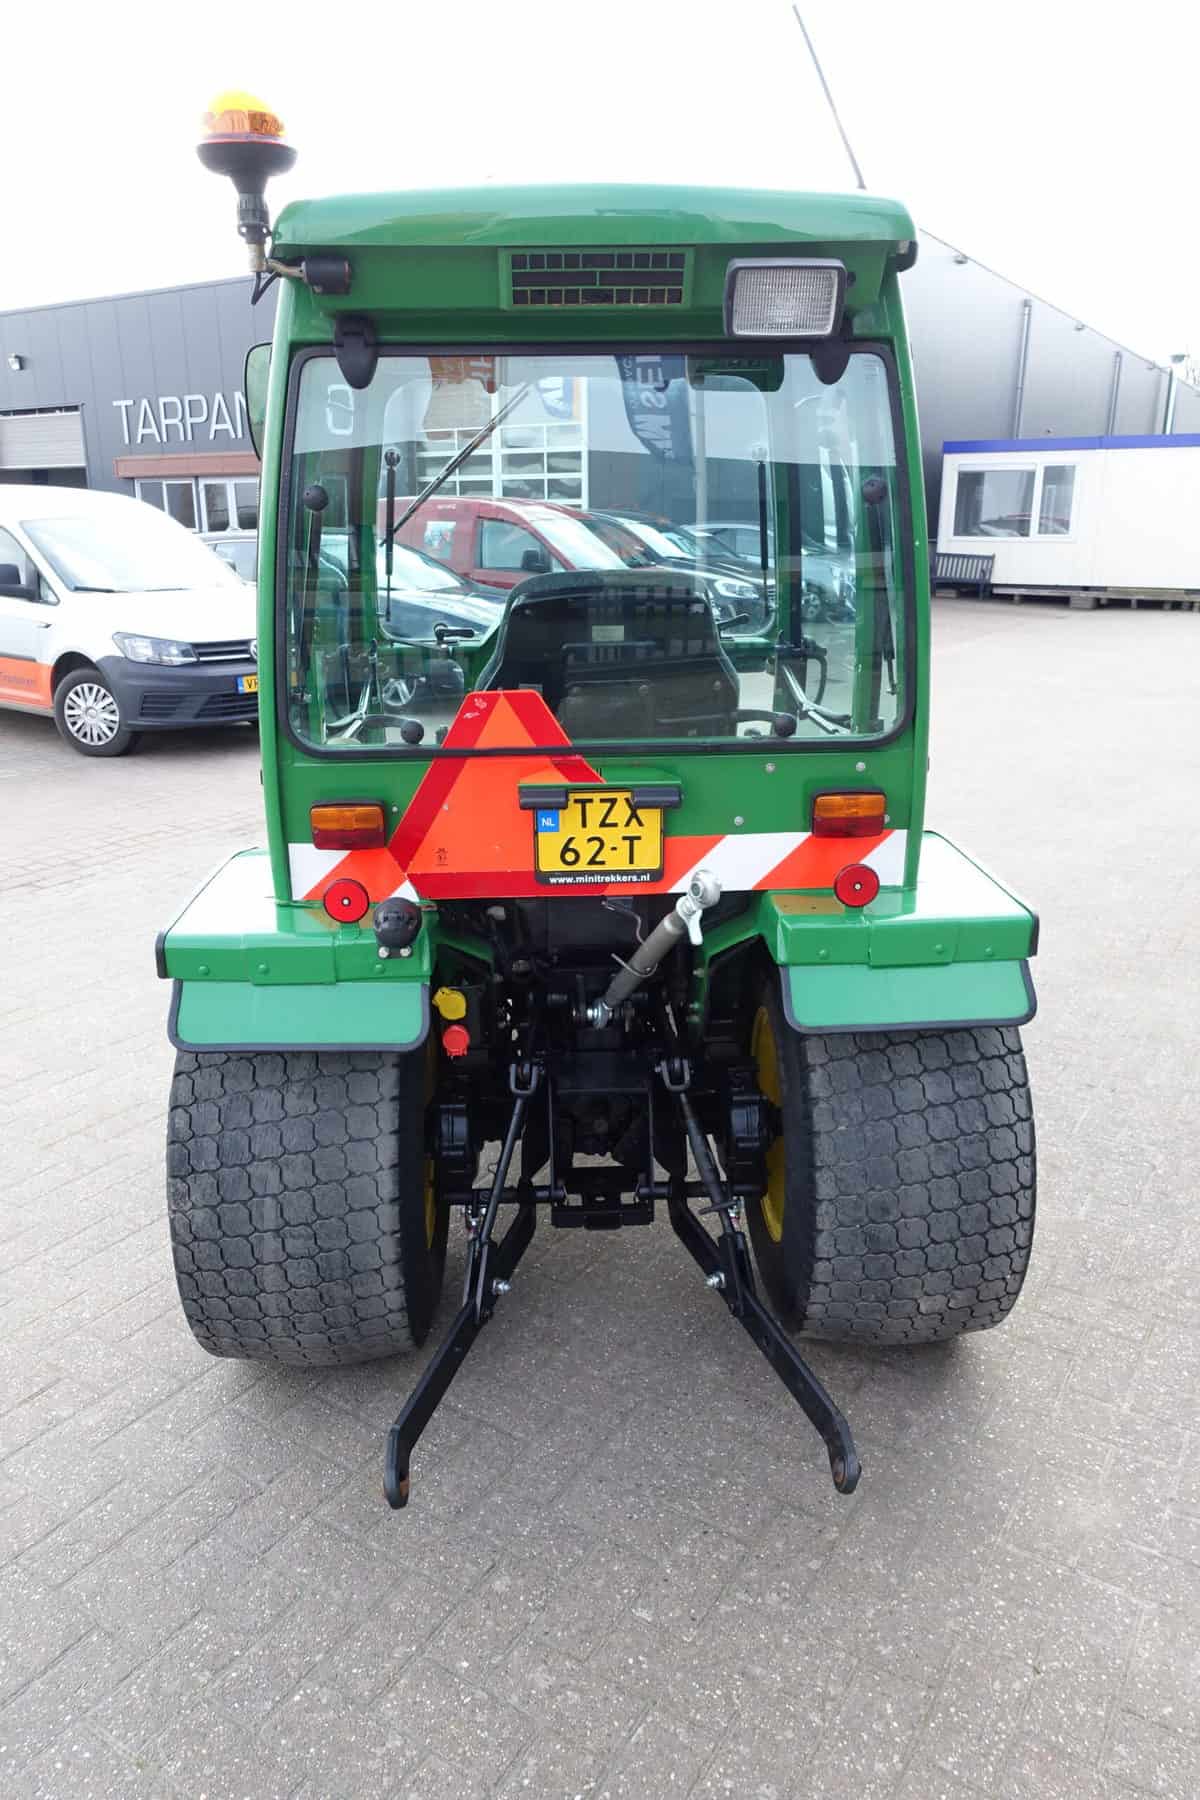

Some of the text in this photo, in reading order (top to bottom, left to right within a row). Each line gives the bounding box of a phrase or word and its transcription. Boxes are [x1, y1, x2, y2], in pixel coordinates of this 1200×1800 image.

[541, 797, 644, 829] NL TZX
[559, 835, 642, 866] 62-T
[548, 873, 651, 884] www.minitrekkers.nl
